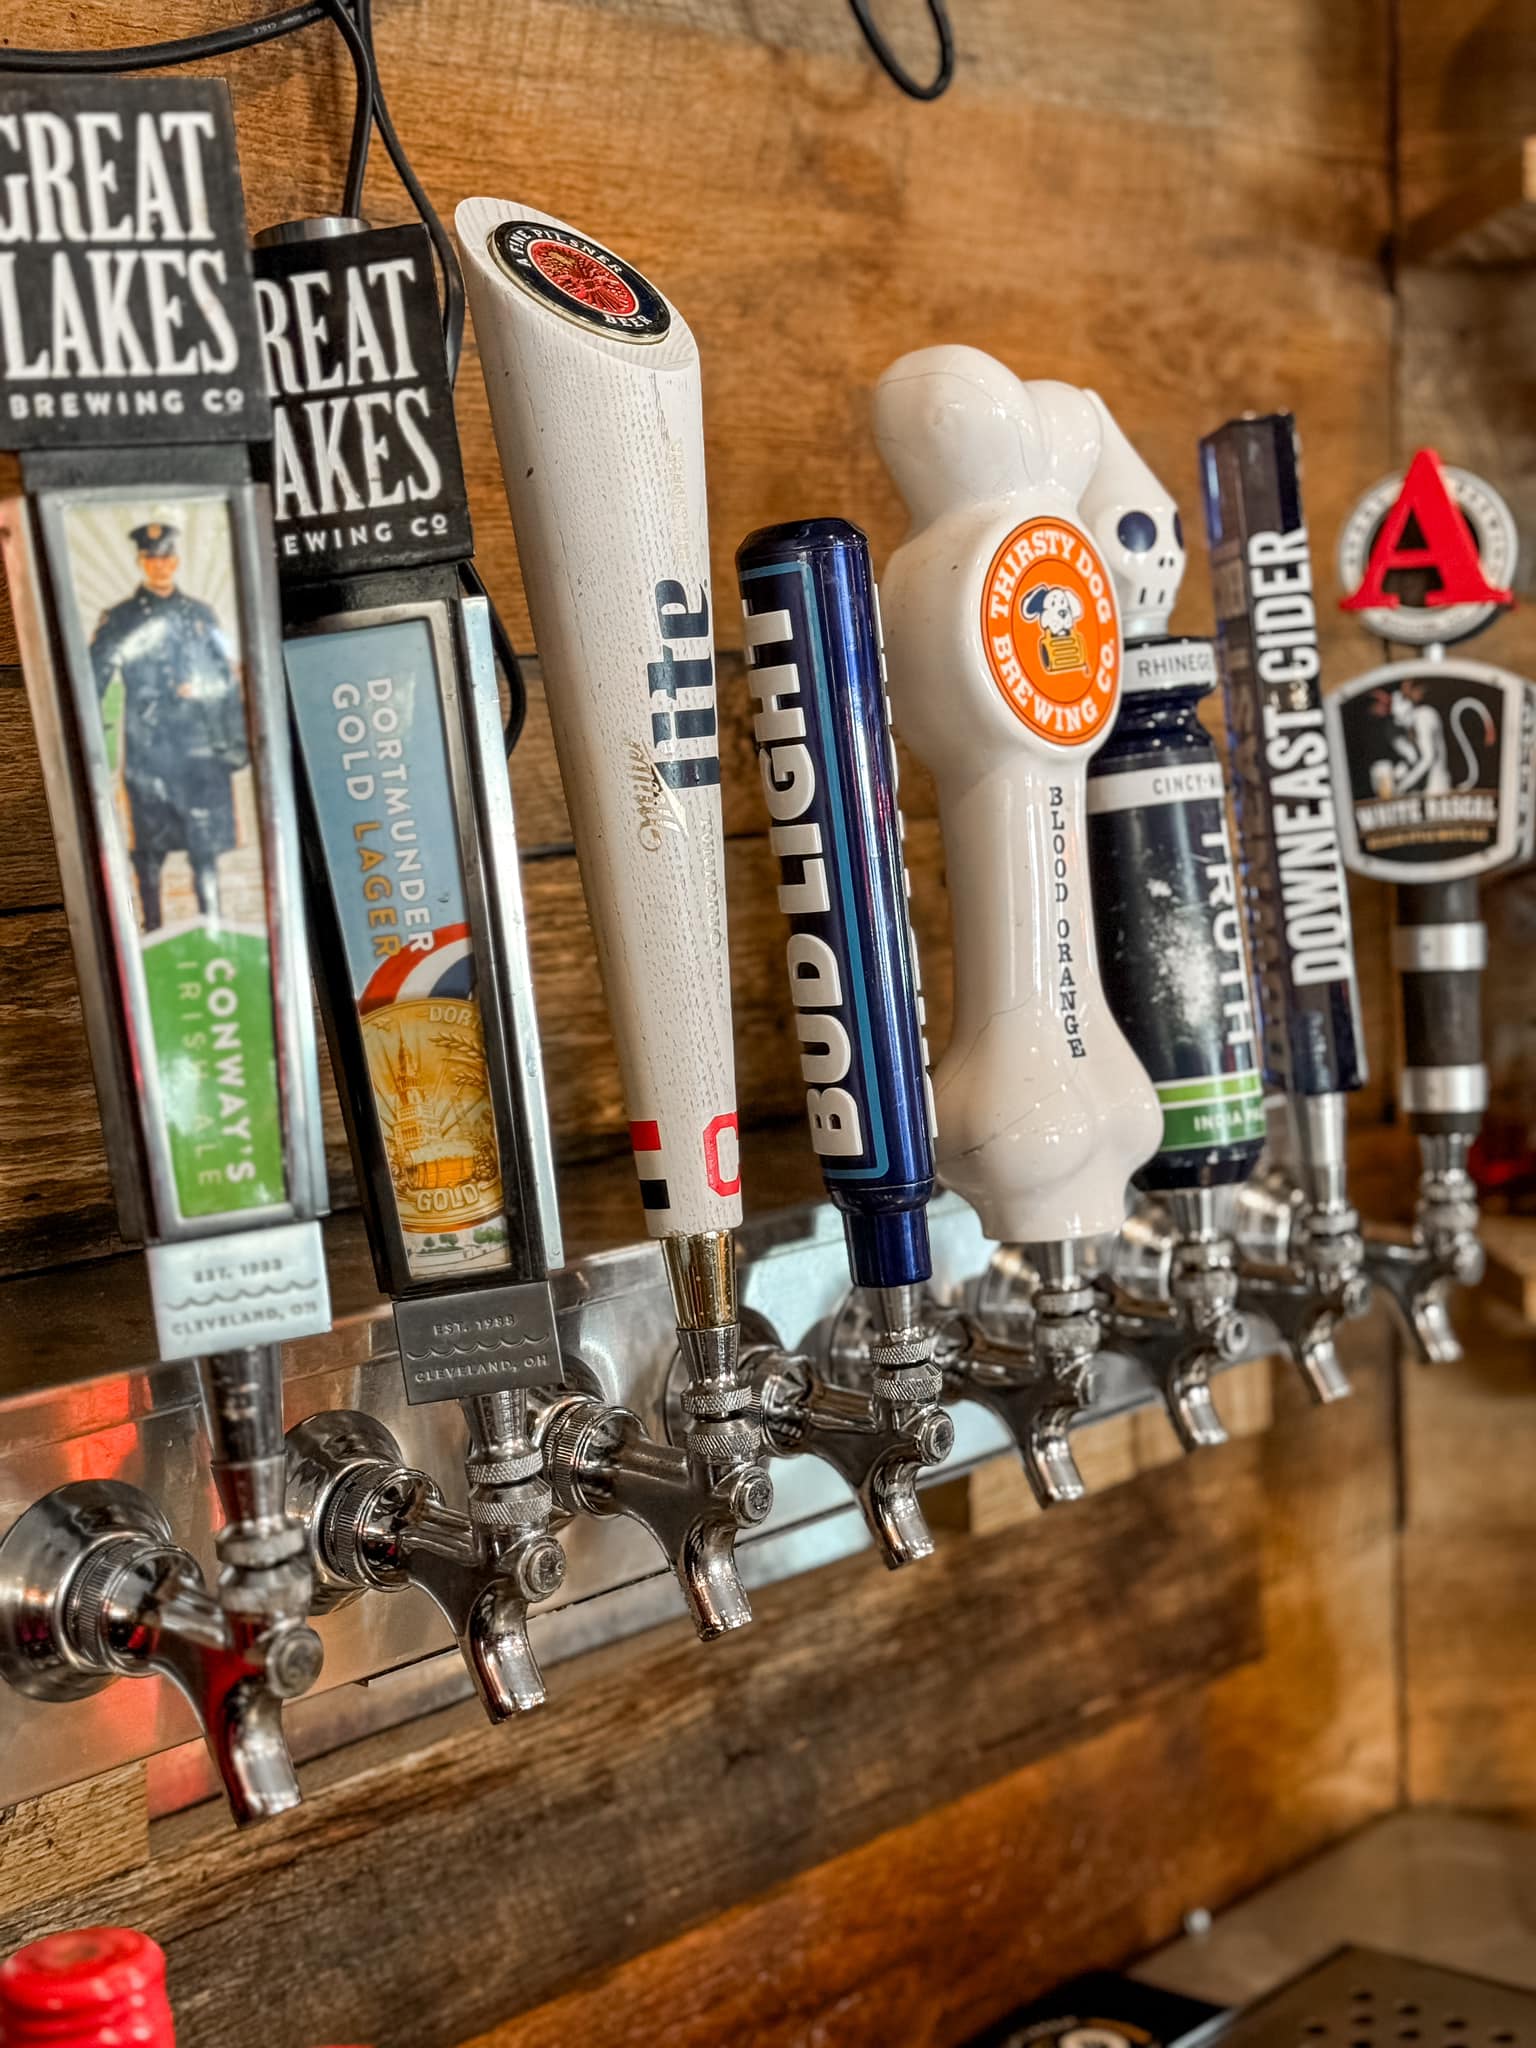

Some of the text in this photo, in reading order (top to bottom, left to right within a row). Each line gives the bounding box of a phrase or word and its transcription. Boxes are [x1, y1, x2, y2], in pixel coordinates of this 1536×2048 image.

[0, 250, 239, 381] LAKES
[509, 229, 622, 273] A FINE PILSNER
[253, 258, 420, 398] REAT
[603, 314, 653, 328] BEER
[9, 391, 185, 420] BREWING
[275, 387, 442, 521] AKES
[284, 522, 393, 556] EWING
[990, 529, 1113, 625] THIRSTY DOG
[1339, 447, 1519, 613] A
[647, 579, 721, 789] lite
[993, 632, 1099, 733] BREWING
[332, 682, 402, 958] GOLD LAGER
[367, 677, 435, 954] DORTMUNDER
[1248, 527, 1351, 987] DOWNEAST CIDER
[742, 598, 864, 1157] BUD LIGHT
[1049, 786, 1087, 1059] BLOOD ORANGE
[1201, 818, 1255, 1045] TRUTH
[204, 957, 256, 1184] CONWAY'S
[194, 1114, 223, 1185] ALE
[416, 1183, 480, 1213] GOLD
[413, 1353, 549, 1384] CLEVELAND, OH
[432, 1314, 516, 1337] EST. 1988
